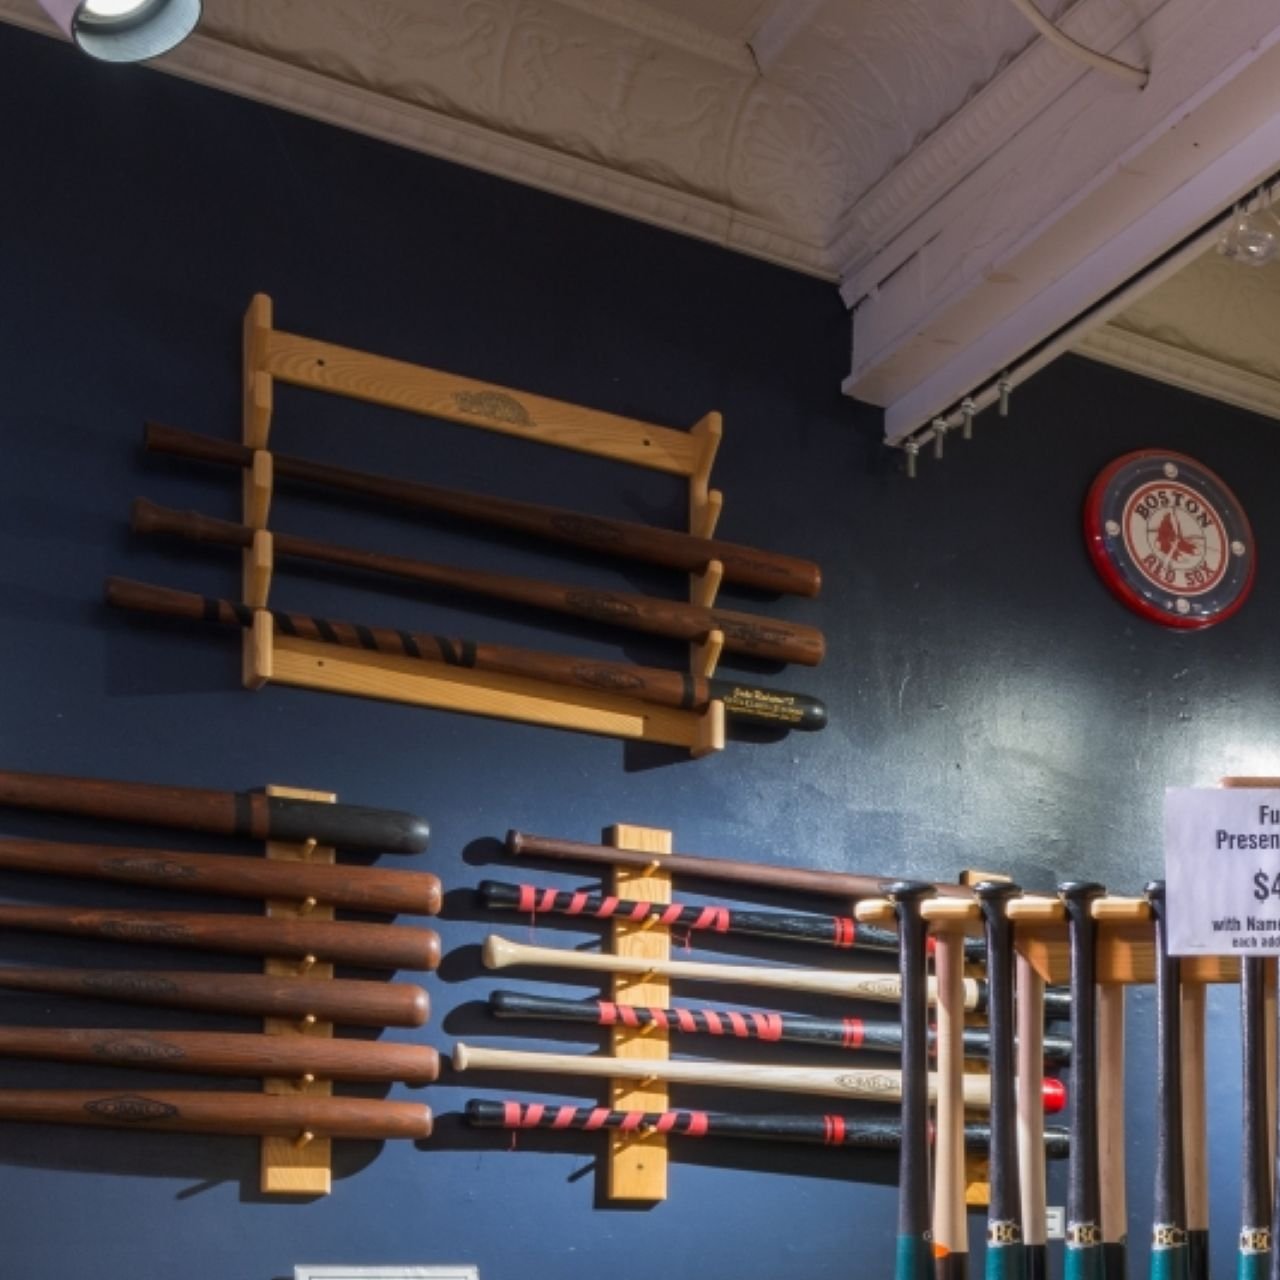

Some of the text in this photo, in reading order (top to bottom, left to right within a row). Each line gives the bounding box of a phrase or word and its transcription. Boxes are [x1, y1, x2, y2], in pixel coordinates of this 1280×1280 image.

[1135, 490, 1213, 529] BOSTON
[1143, 553, 1215, 586] RED SOX
[1211, 916, 1242, 932] with
[1231, 934, 1257, 948] each
